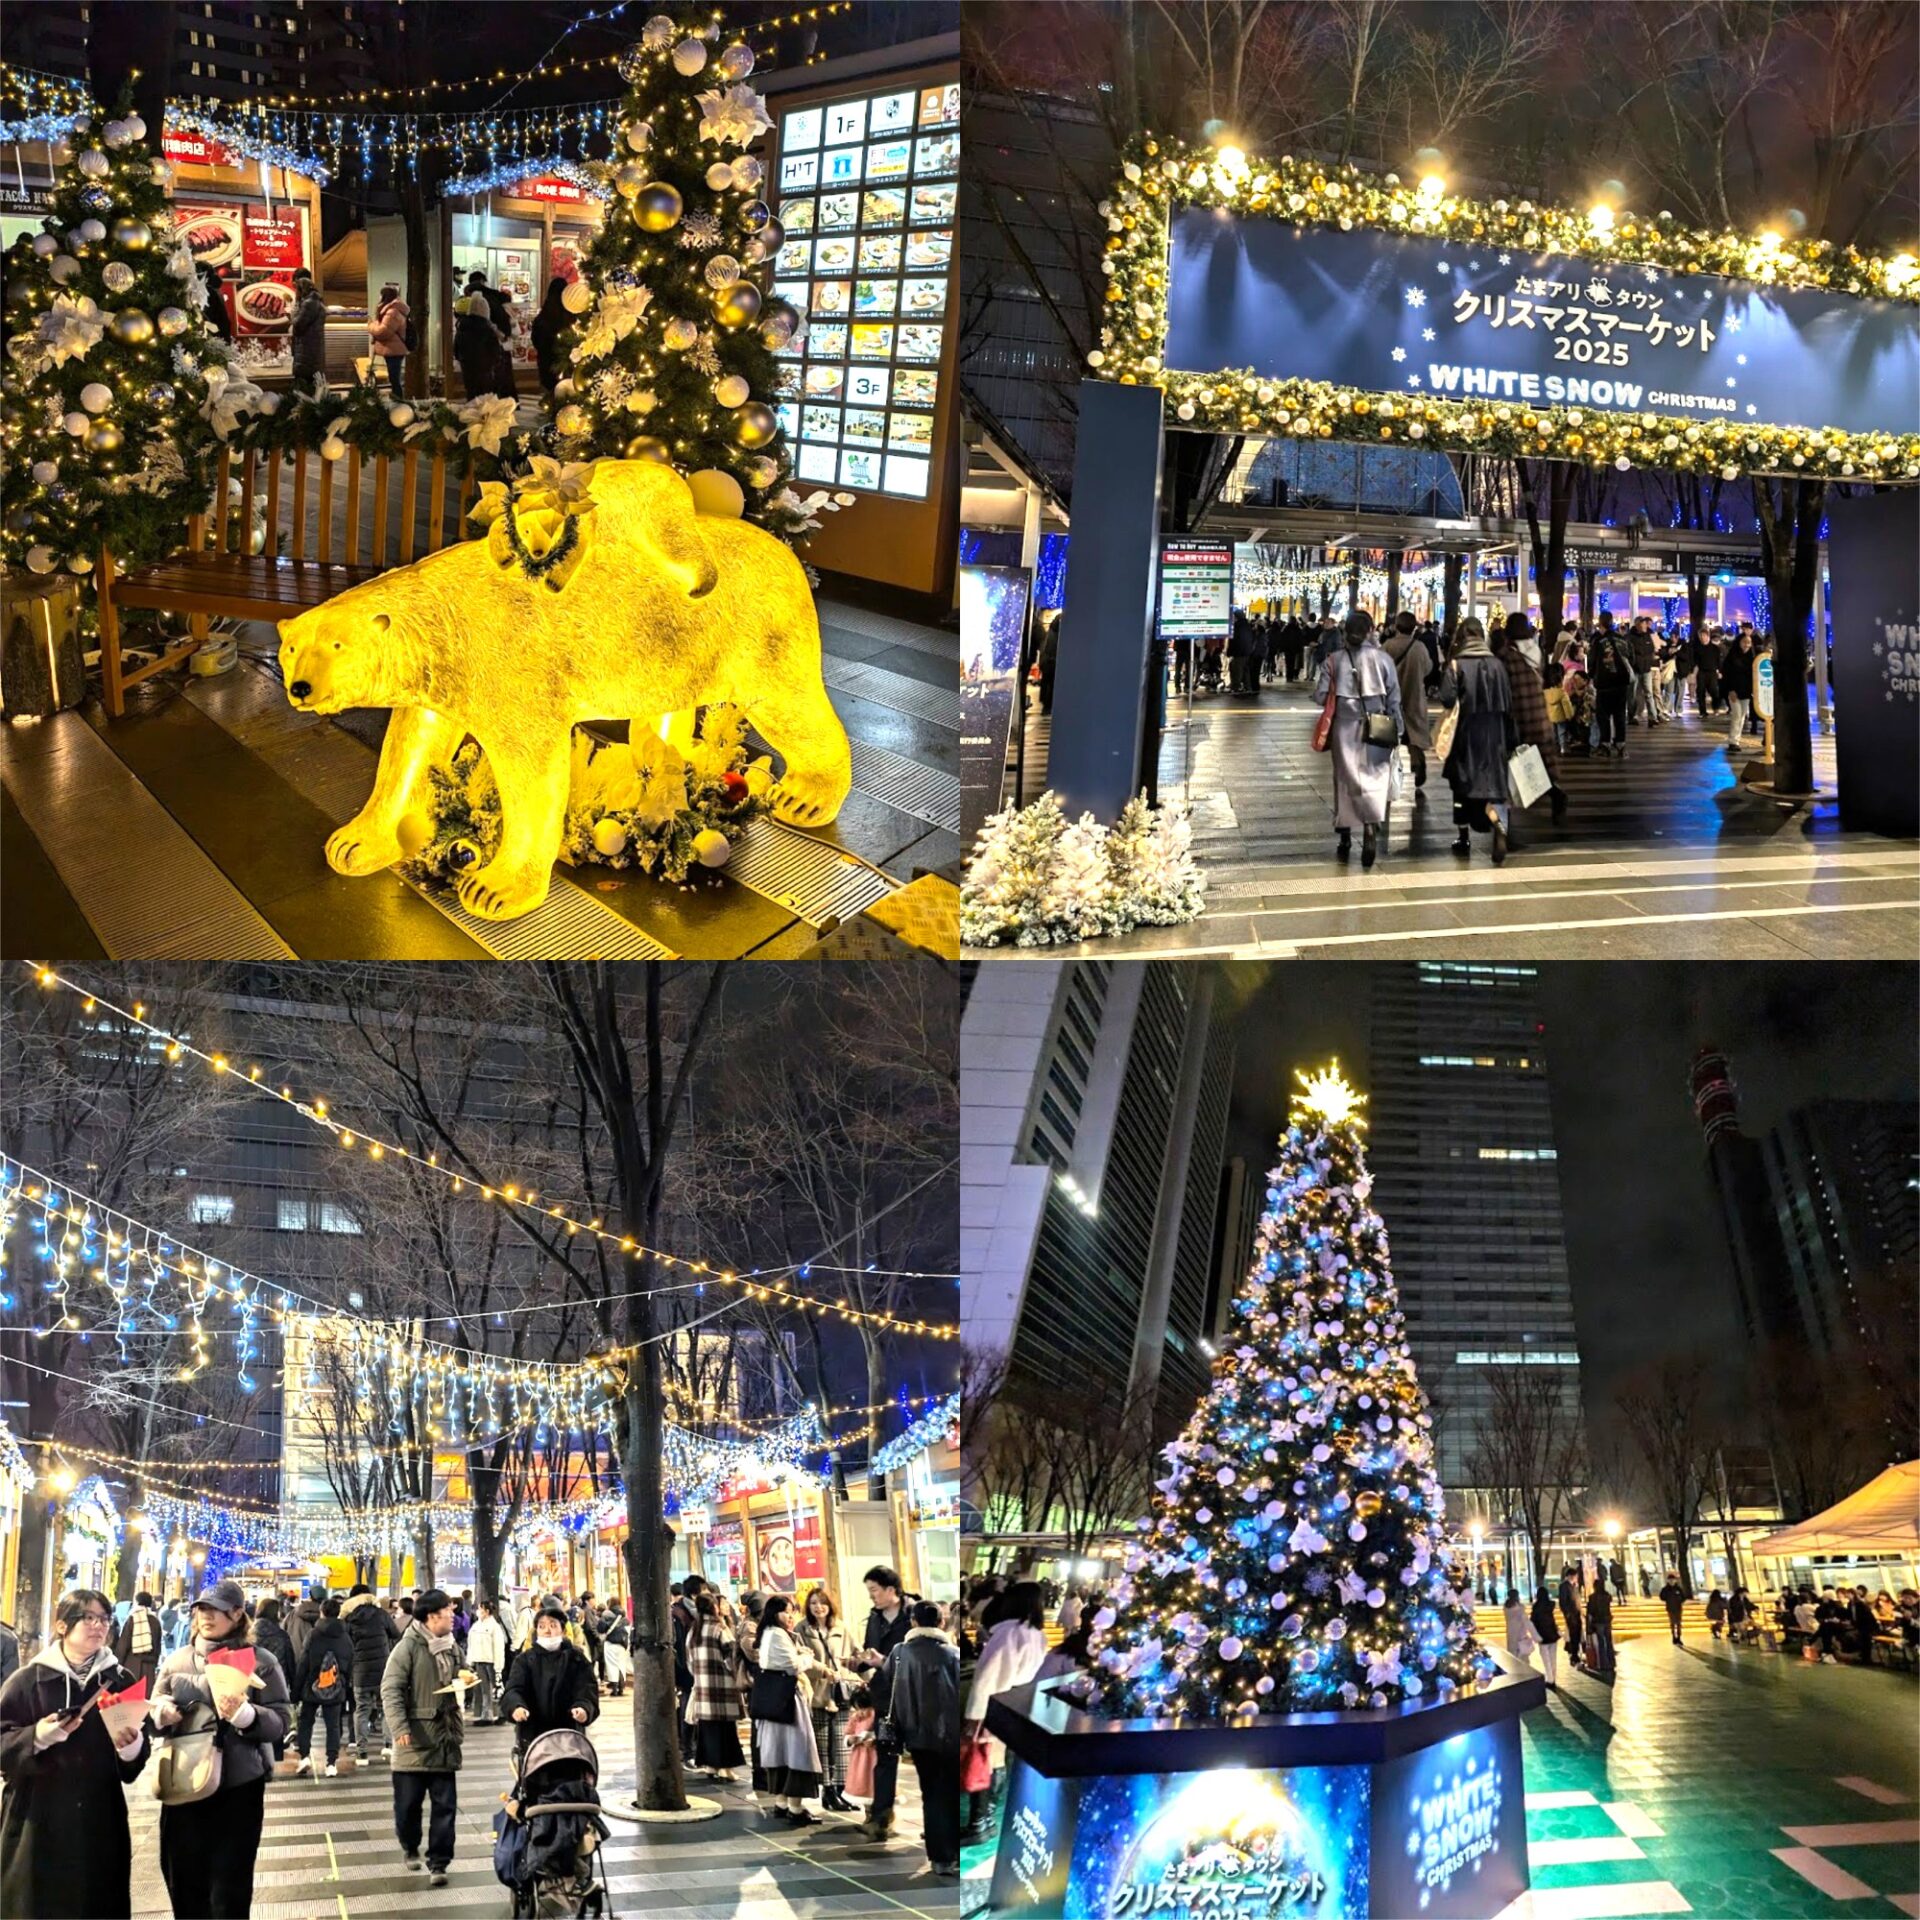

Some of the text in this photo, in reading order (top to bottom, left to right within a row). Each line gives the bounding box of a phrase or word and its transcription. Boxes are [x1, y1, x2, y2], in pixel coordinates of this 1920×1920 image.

[1515, 275, 1664, 310] たまアリ タウン
[1453, 289, 1716, 352] クリスマスマーケット
[1553, 337, 1629, 367] 2025
[856, 378, 880, 395] 3F
[1428, 364, 1737, 413] WHITE SNOW CHRISTMAS
[1422, 1771, 1494, 1833] WHITE
[1424, 1805, 1493, 1867] SNOW
[1164, 1856, 1283, 1879] たまアリ タウン
[1427, 1833, 1493, 1887] CHRISTMAS
[1113, 1872, 1324, 1913] クリスマスマーケット
